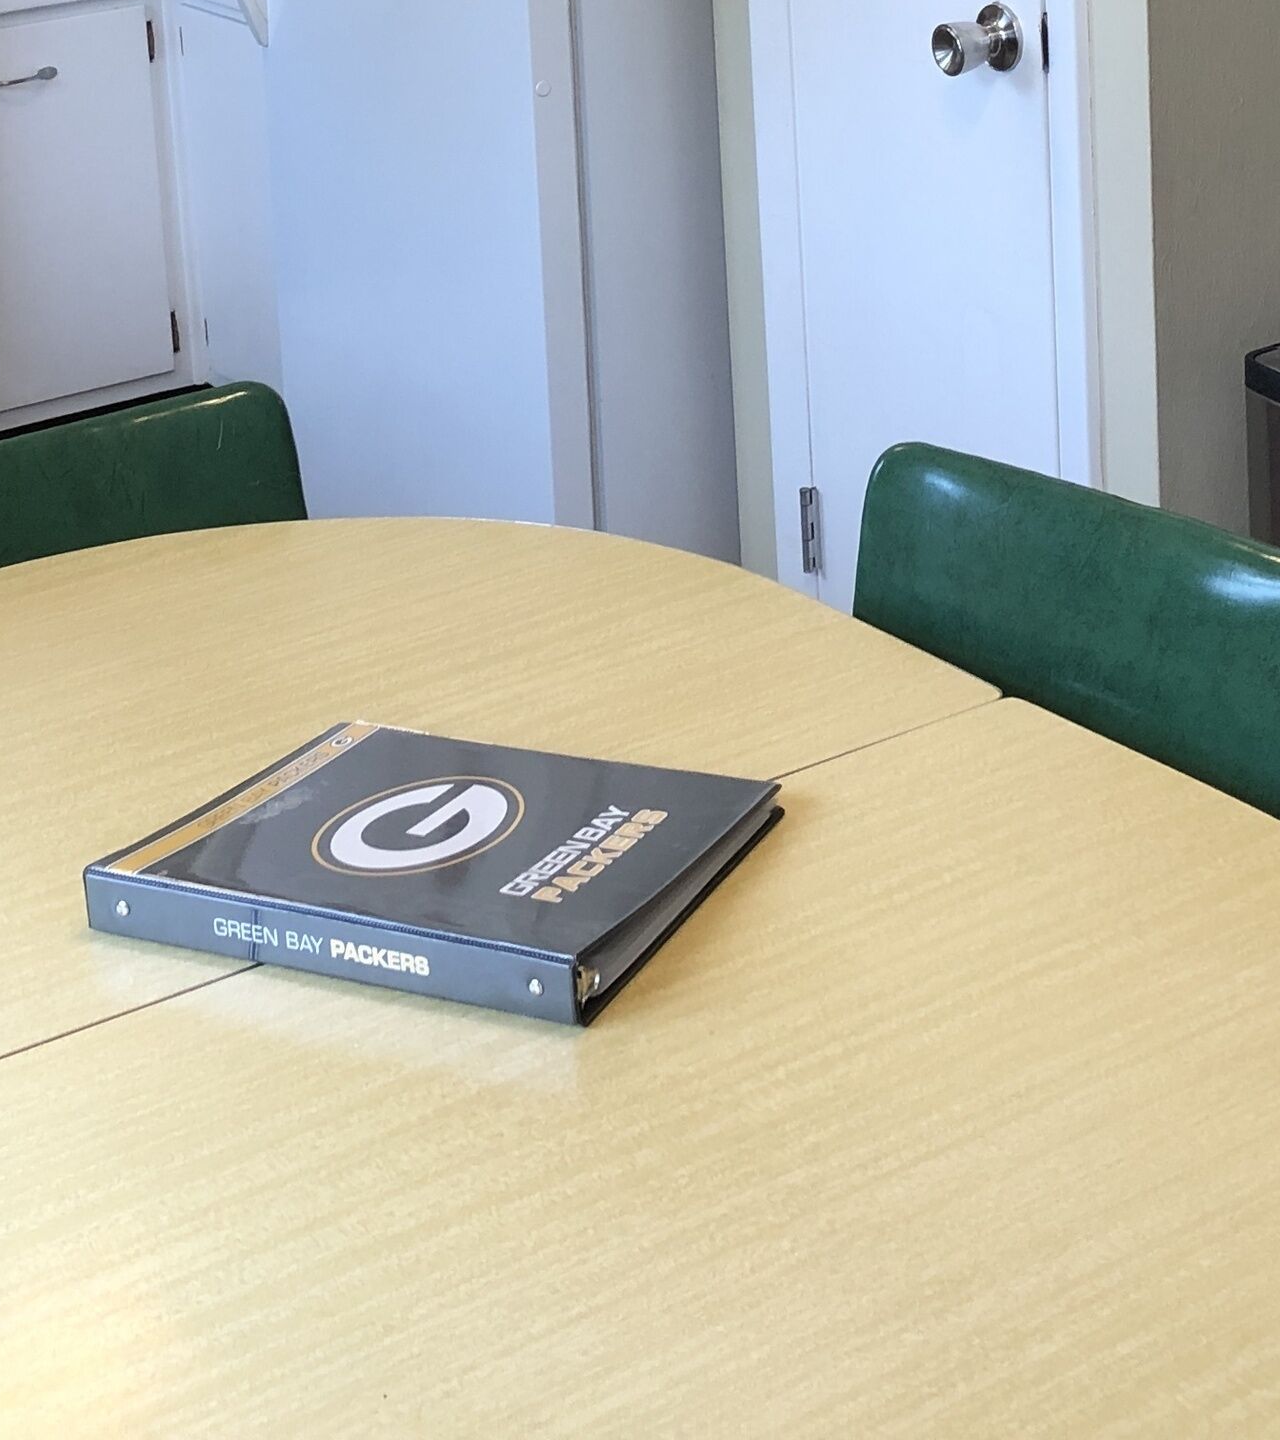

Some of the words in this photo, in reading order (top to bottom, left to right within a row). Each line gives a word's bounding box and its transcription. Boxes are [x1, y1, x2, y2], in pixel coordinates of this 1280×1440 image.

[329, 783, 509, 870] G
[499, 838, 584, 897] GREEN
[576, 804, 631, 844] BAY
[530, 808, 669, 904] PACKERS
[213, 917, 279, 947] GREEN
[285, 931, 323, 955] BAY
[329, 938, 430, 977] PACKERS
